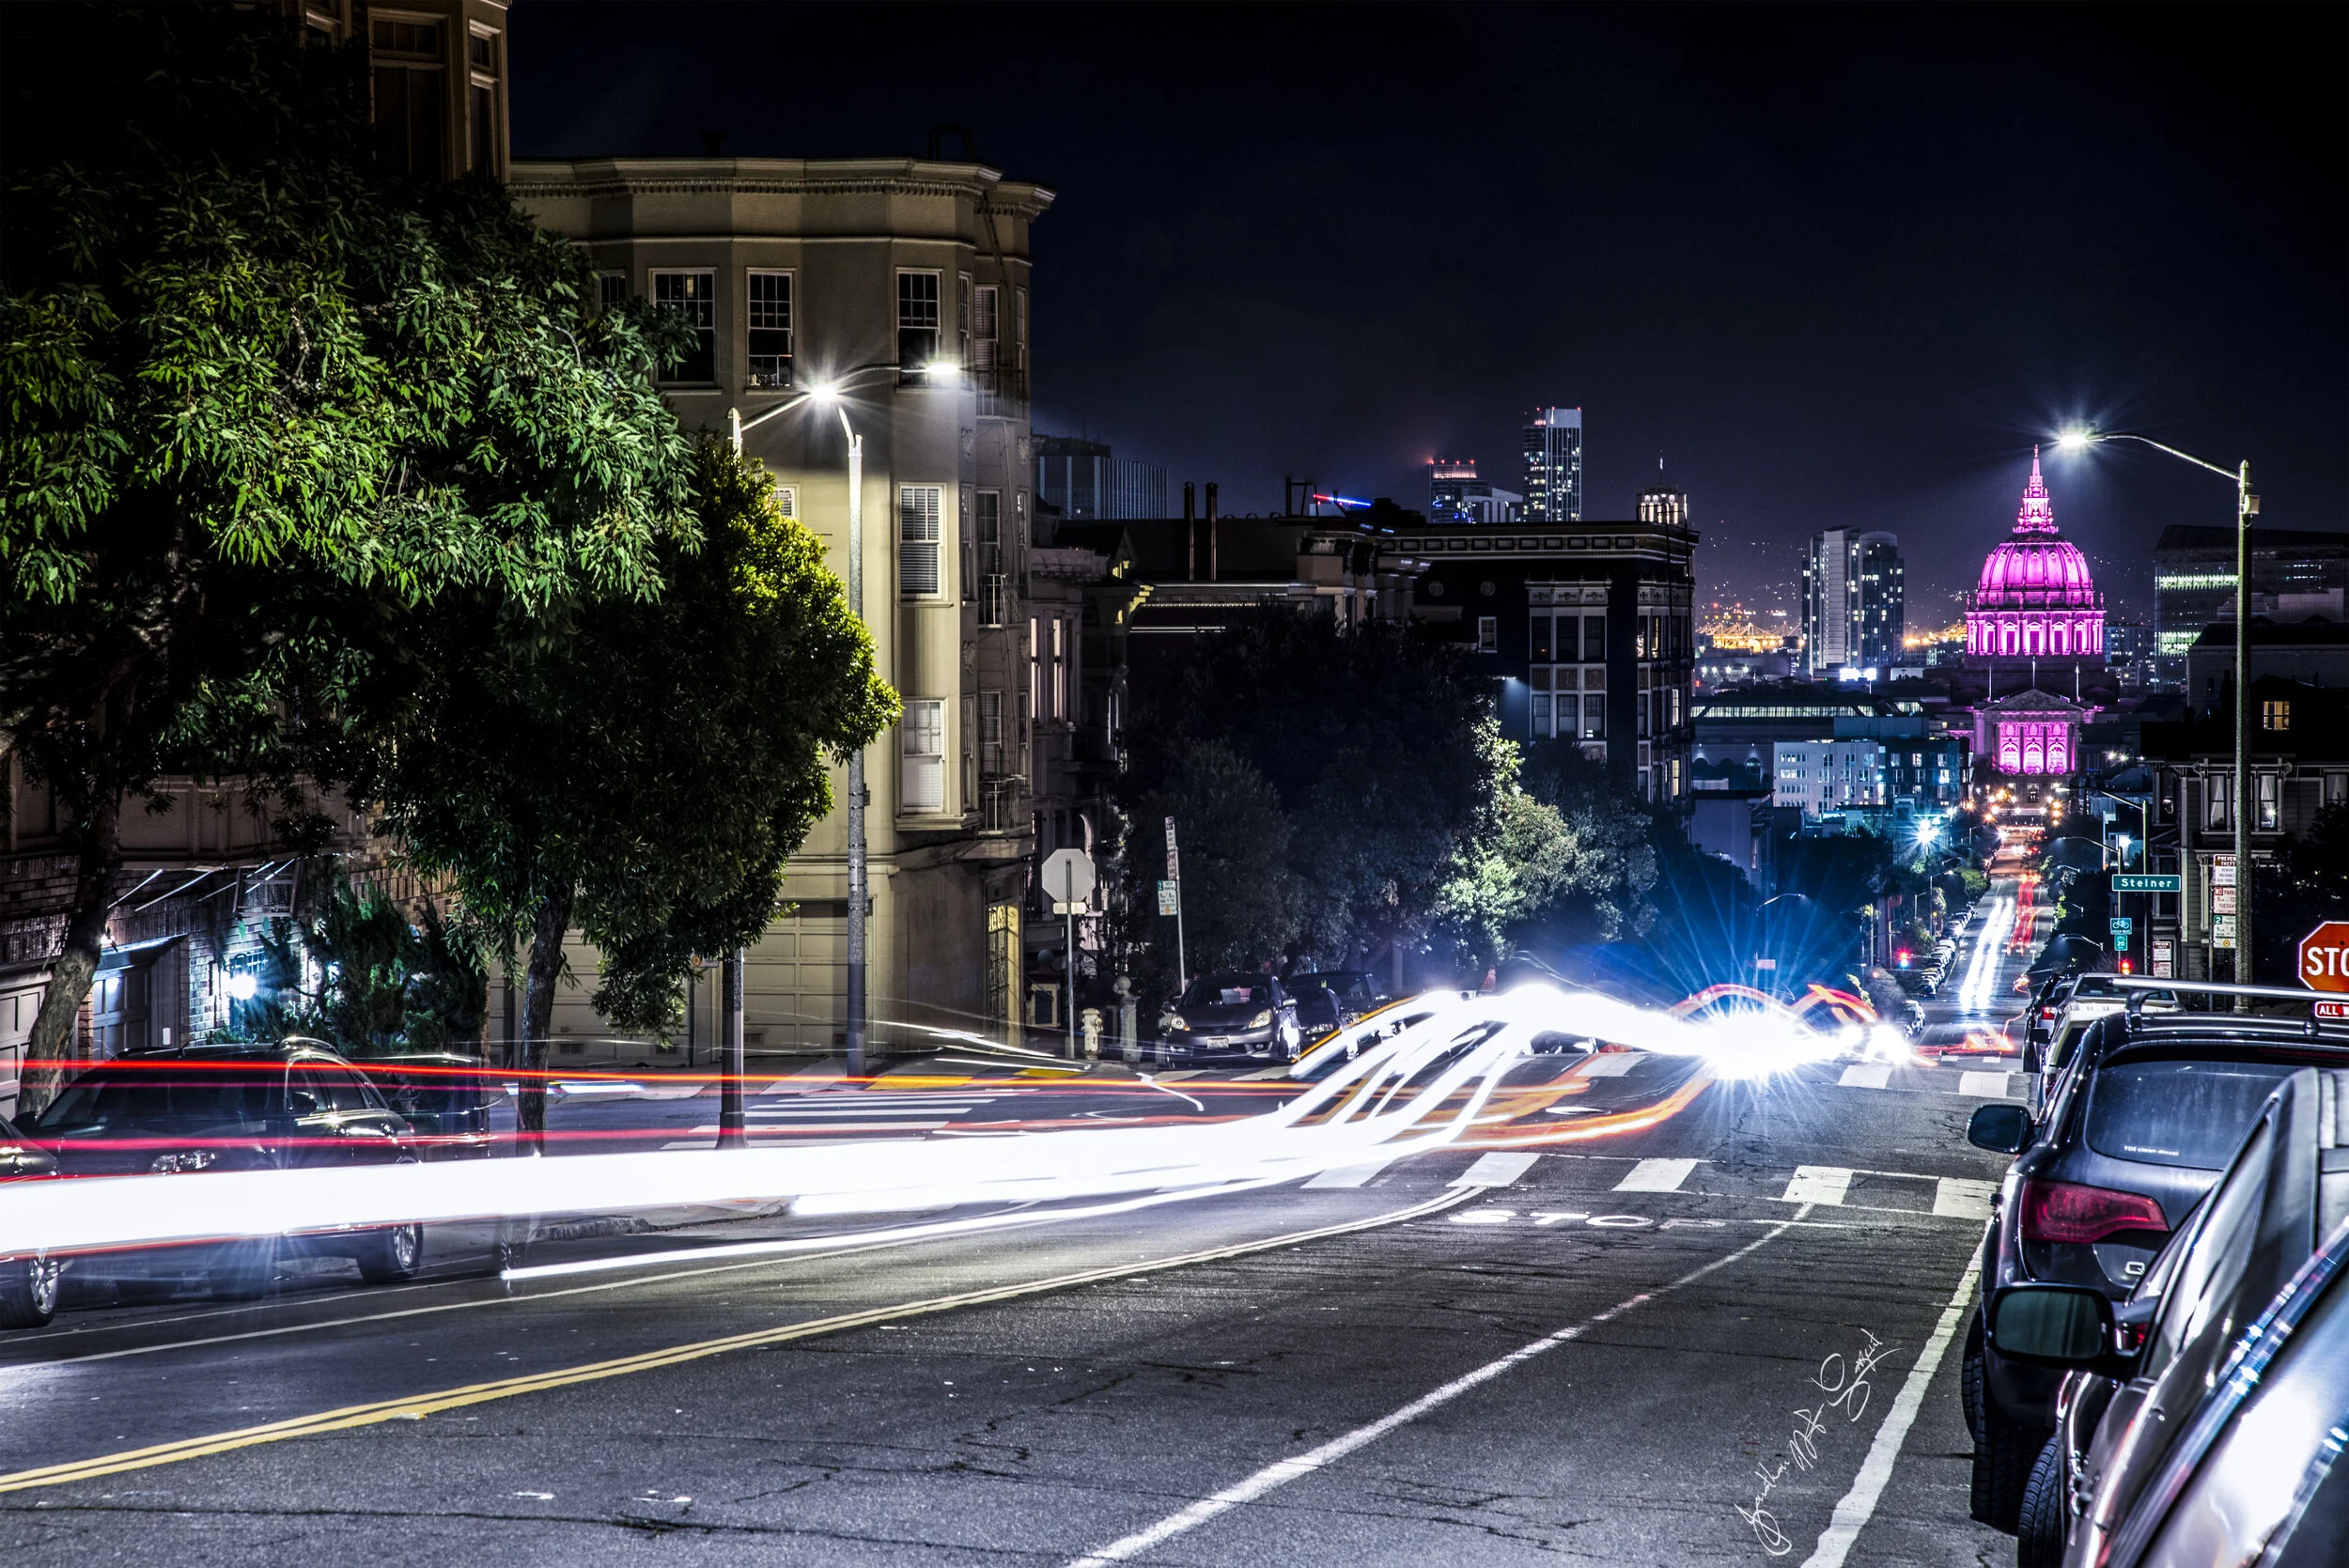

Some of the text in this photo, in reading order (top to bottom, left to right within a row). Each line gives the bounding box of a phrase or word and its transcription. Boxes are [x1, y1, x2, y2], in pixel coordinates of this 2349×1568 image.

[2121, 878, 2172, 888] Steiner
[2216, 916, 2221, 924] 2
[2306, 946, 2349, 977] STO
[2319, 1005, 2339, 1016] ALL
